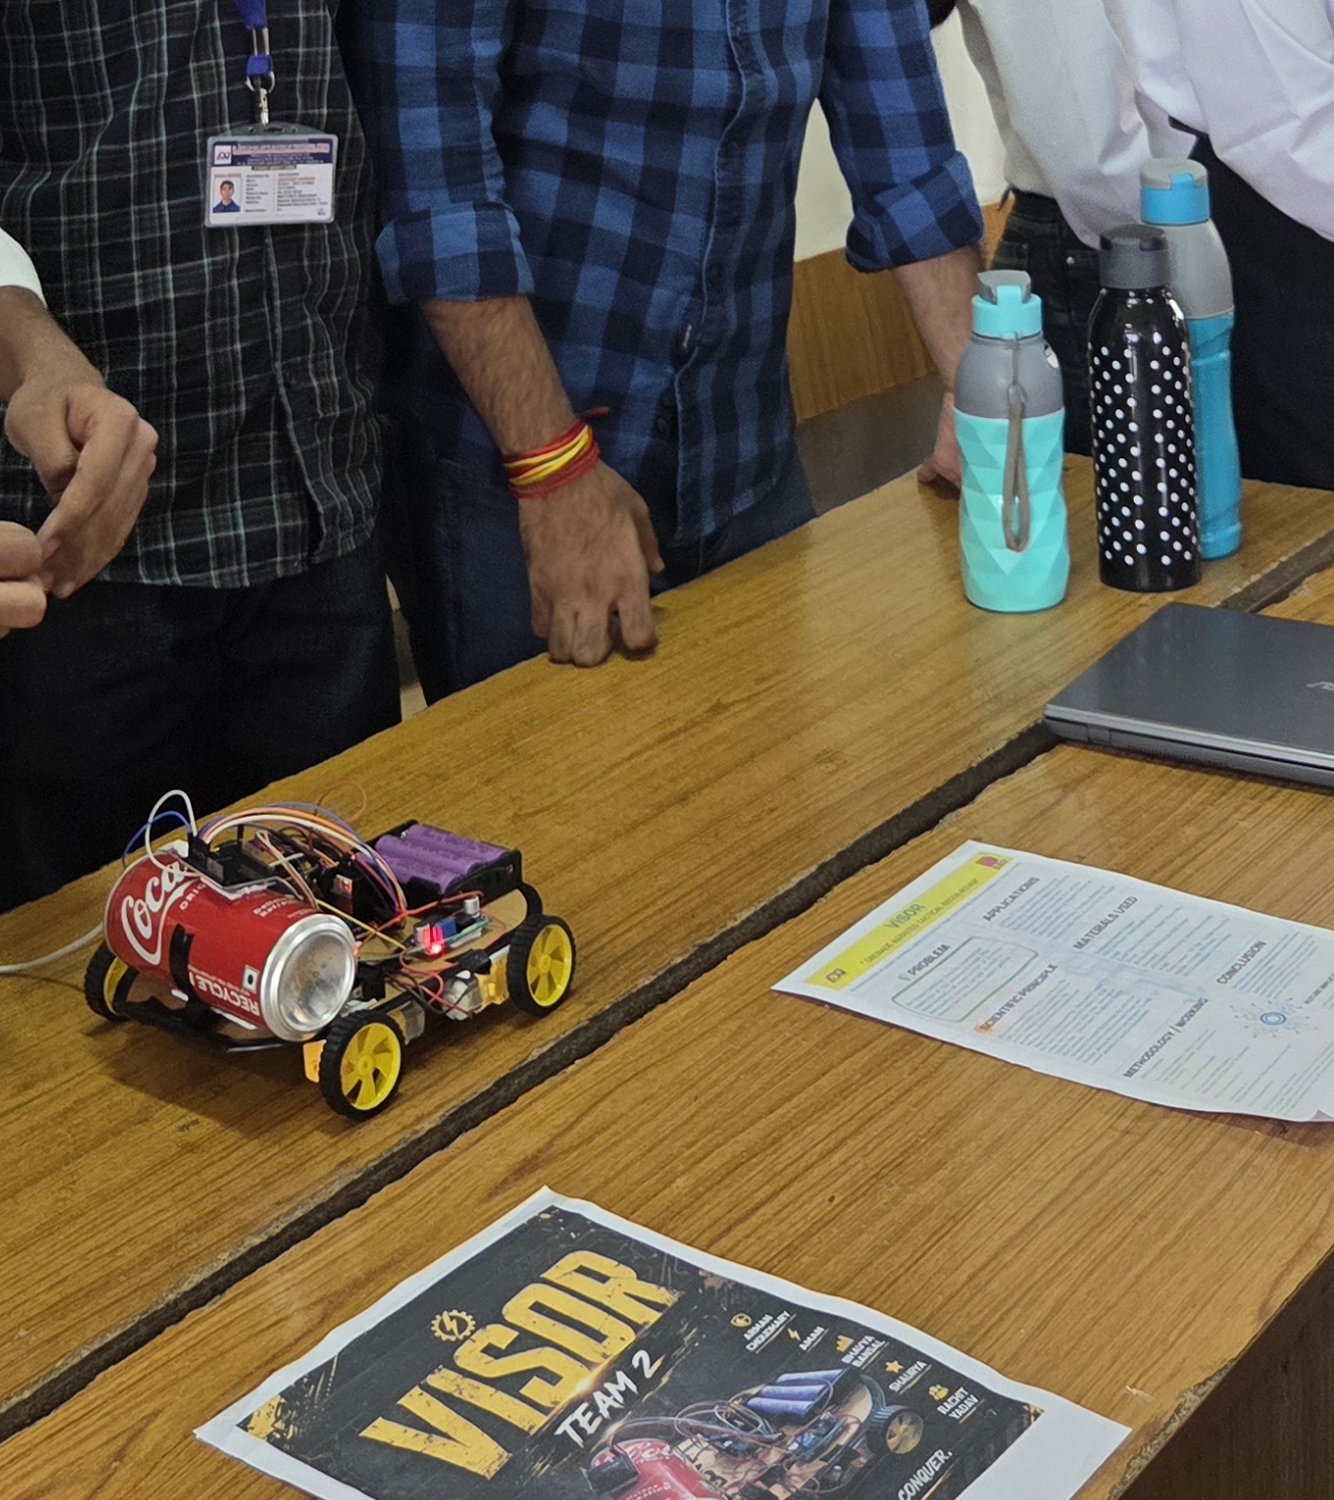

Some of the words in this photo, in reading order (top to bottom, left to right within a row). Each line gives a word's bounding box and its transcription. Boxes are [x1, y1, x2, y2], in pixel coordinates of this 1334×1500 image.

[1073, 911, 1118, 950] MATERIALS
[907, 943, 951, 976] PROBLEM
[1216, 940, 1266, 984] CONCLUSION
[196, 974, 260, 1016] RECYCLE
[979, 992, 1023, 1031] SCIENTIFIC
[1123, 1030, 1176, 1078] METHODOLOGY
[744, 1314, 773, 1340] ARMAN
[746, 1310, 790, 1352] CHOUDHARY
[799, 1326, 825, 1351] AMAN
[359, 1249, 681, 1480] VISOR
[841, 1335, 875, 1364] BHAVYA
[851, 1340, 885, 1368] BANSAL
[888, 1361, 927, 1392] SHAURYA
[553, 1372, 640, 1448] TEAM
[631, 1350, 666, 1380] 2
[936, 1386, 969, 1415] RACHIT
[948, 1394, 979, 1419] YADAV
[898, 1449, 953, 1500] CONQUER.
